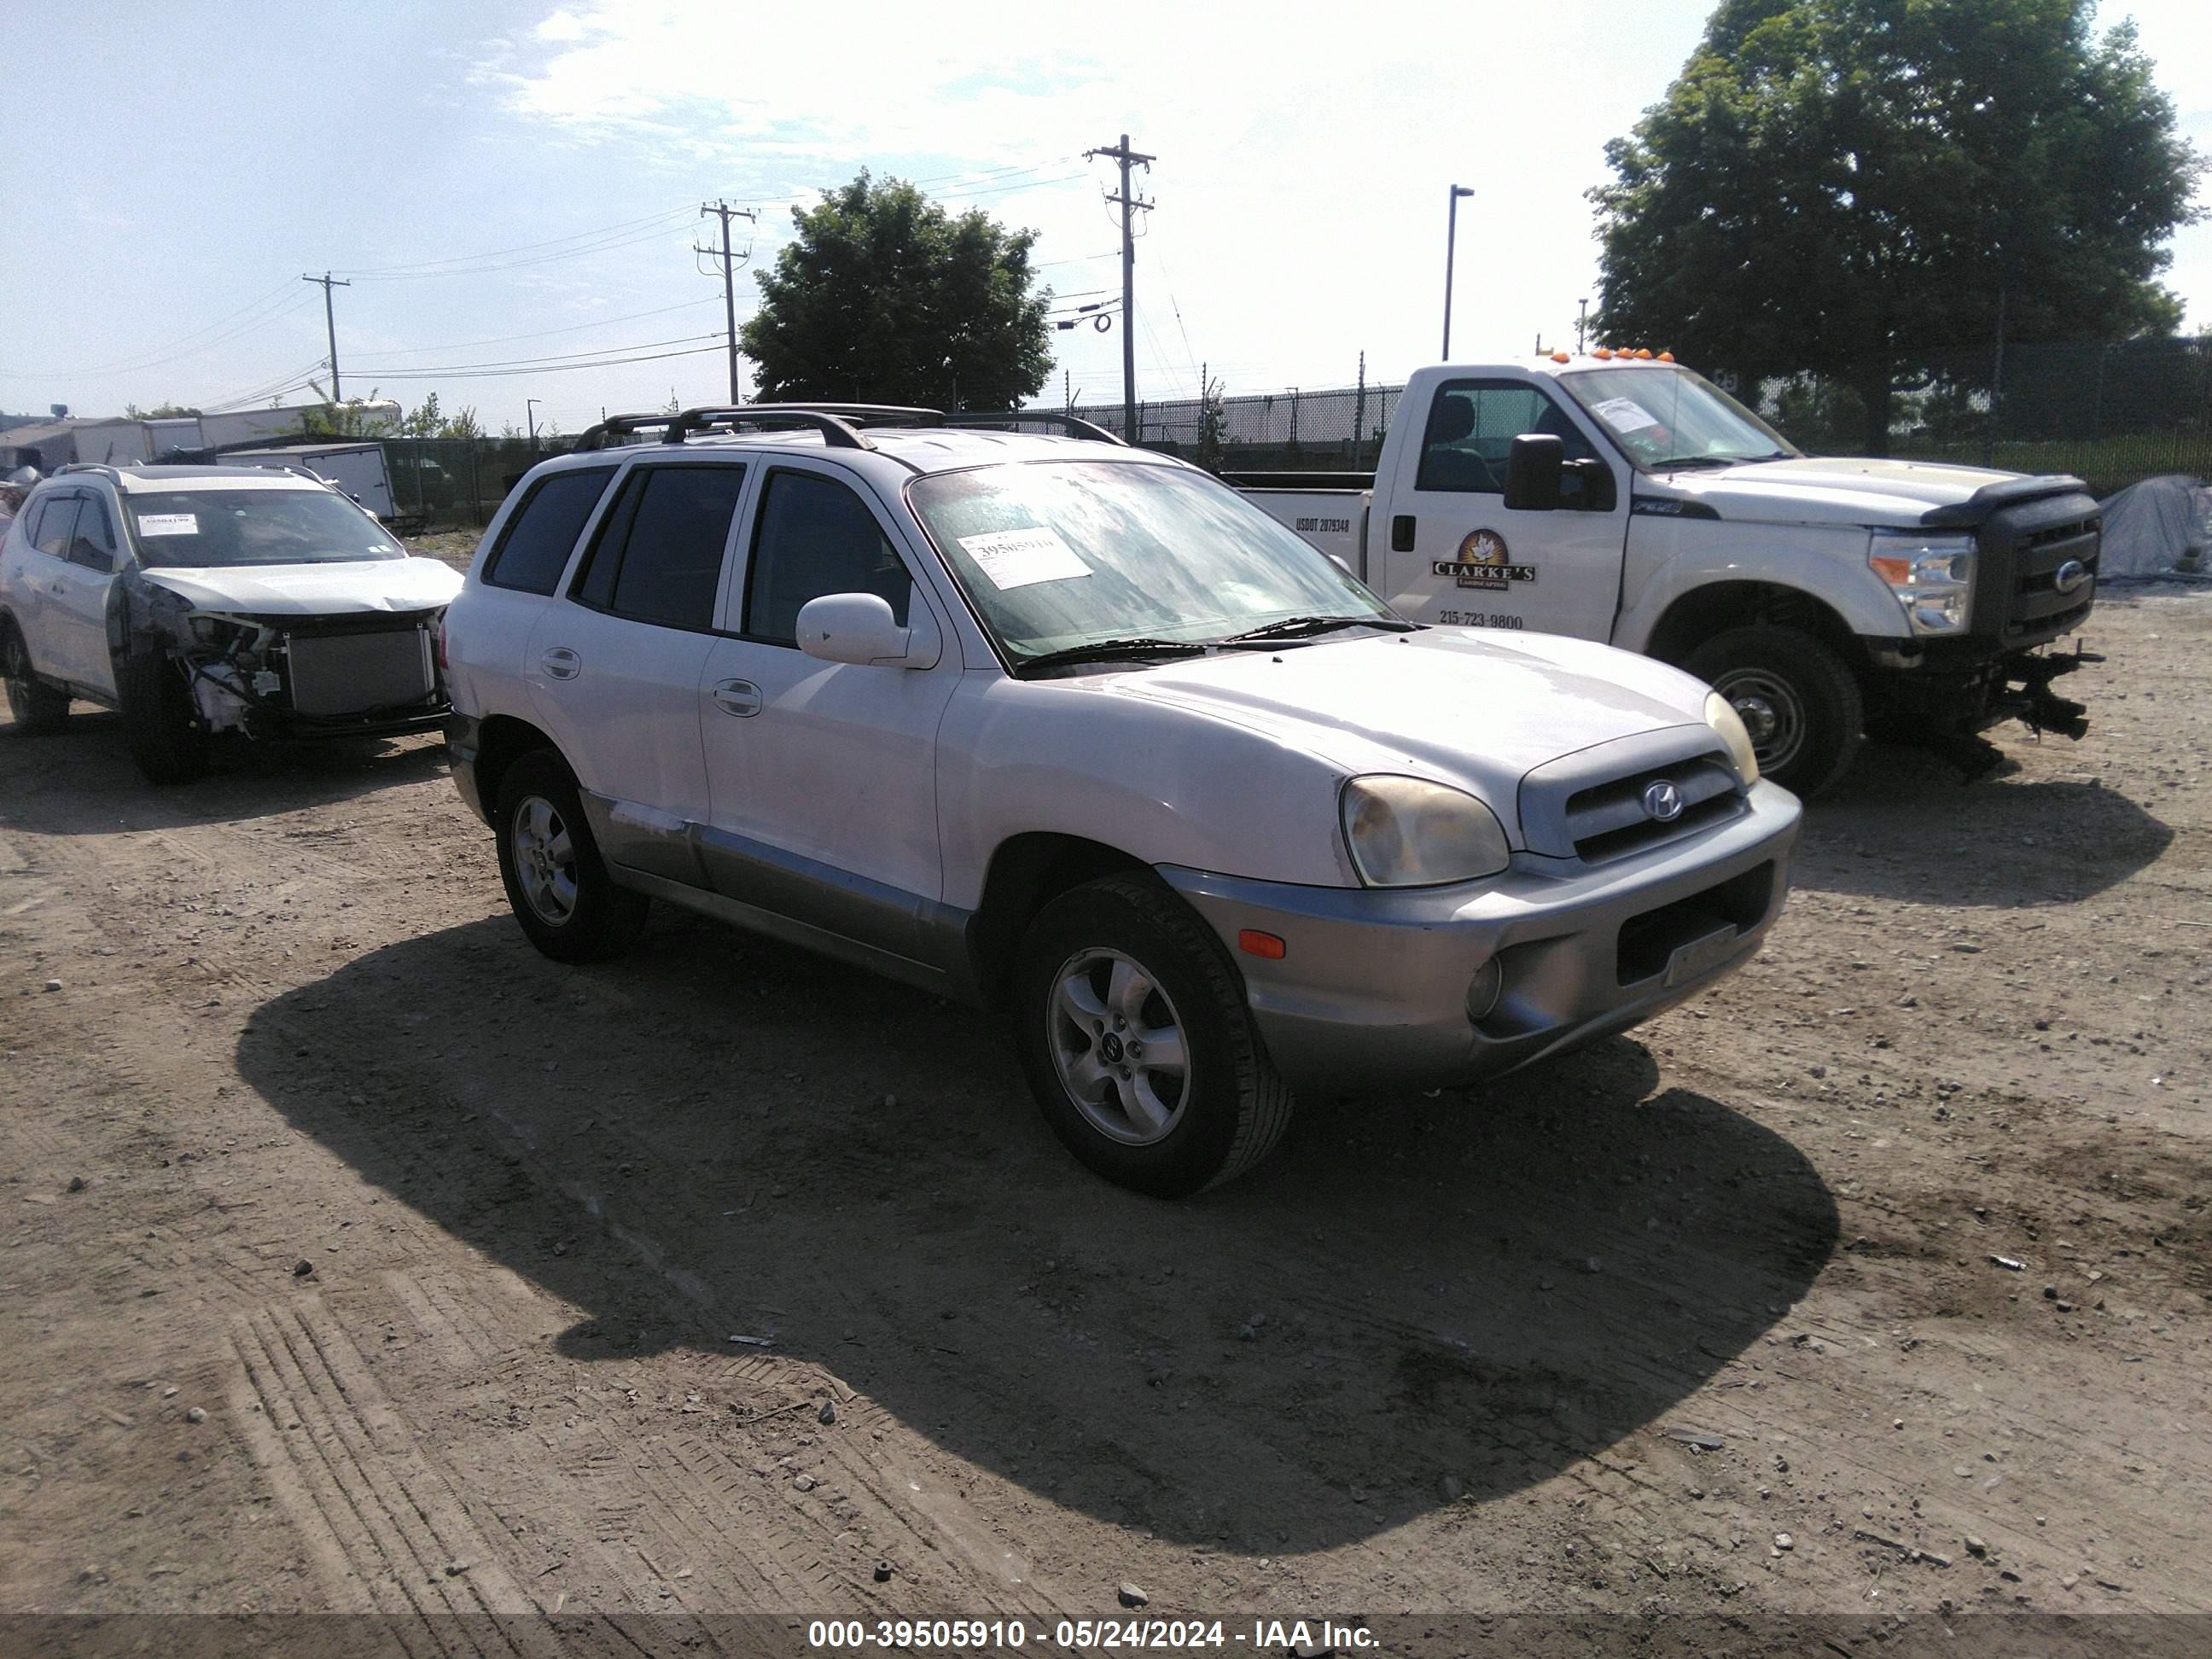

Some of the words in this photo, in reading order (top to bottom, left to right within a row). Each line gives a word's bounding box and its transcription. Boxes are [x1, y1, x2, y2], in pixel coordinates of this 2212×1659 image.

[1296, 517, 1318, 532] USDOT
[1435, 562, 1534, 581] CLARKE'S
[1440, 609, 1523, 630] 215-723-9800
